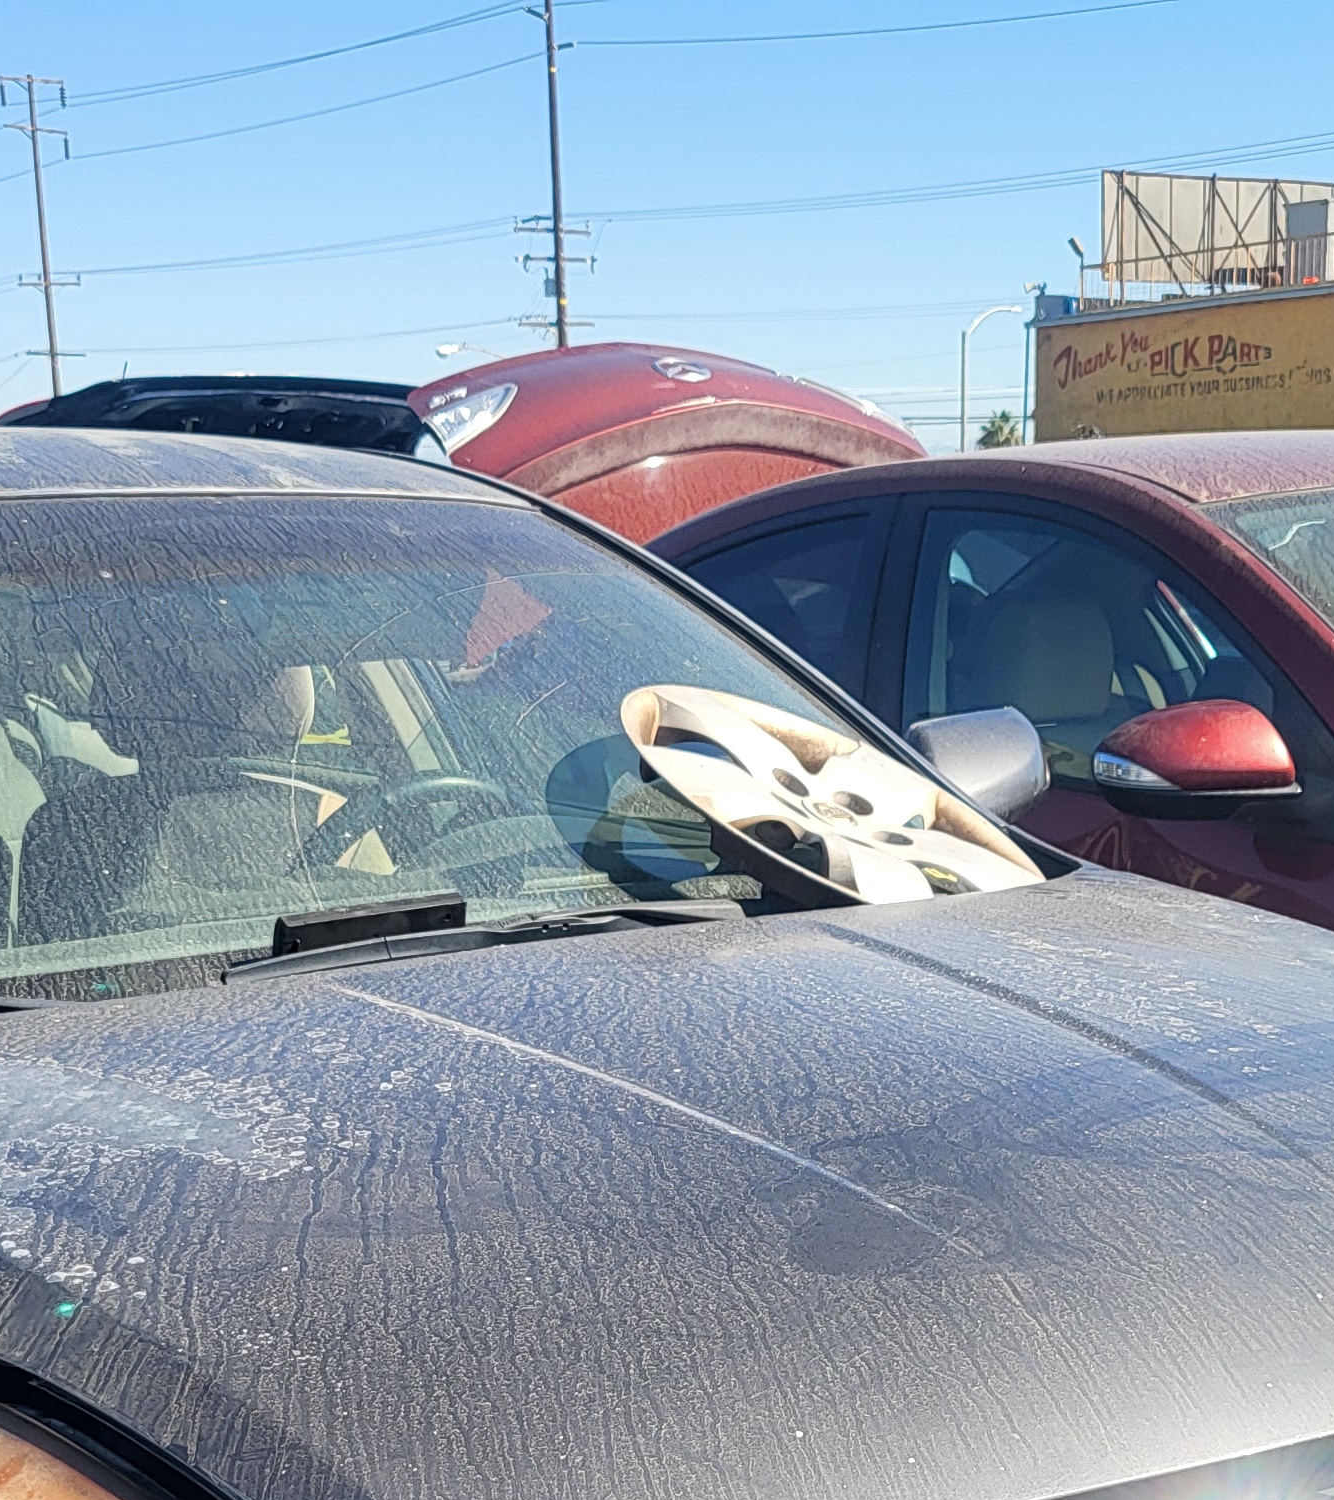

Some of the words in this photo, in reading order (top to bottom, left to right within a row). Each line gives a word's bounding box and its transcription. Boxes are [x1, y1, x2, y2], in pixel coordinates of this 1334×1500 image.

[1052, 342, 1118, 391] Thank
[1120, 331, 1150, 368] You
[1189, 379, 1220, 398] YOUR
